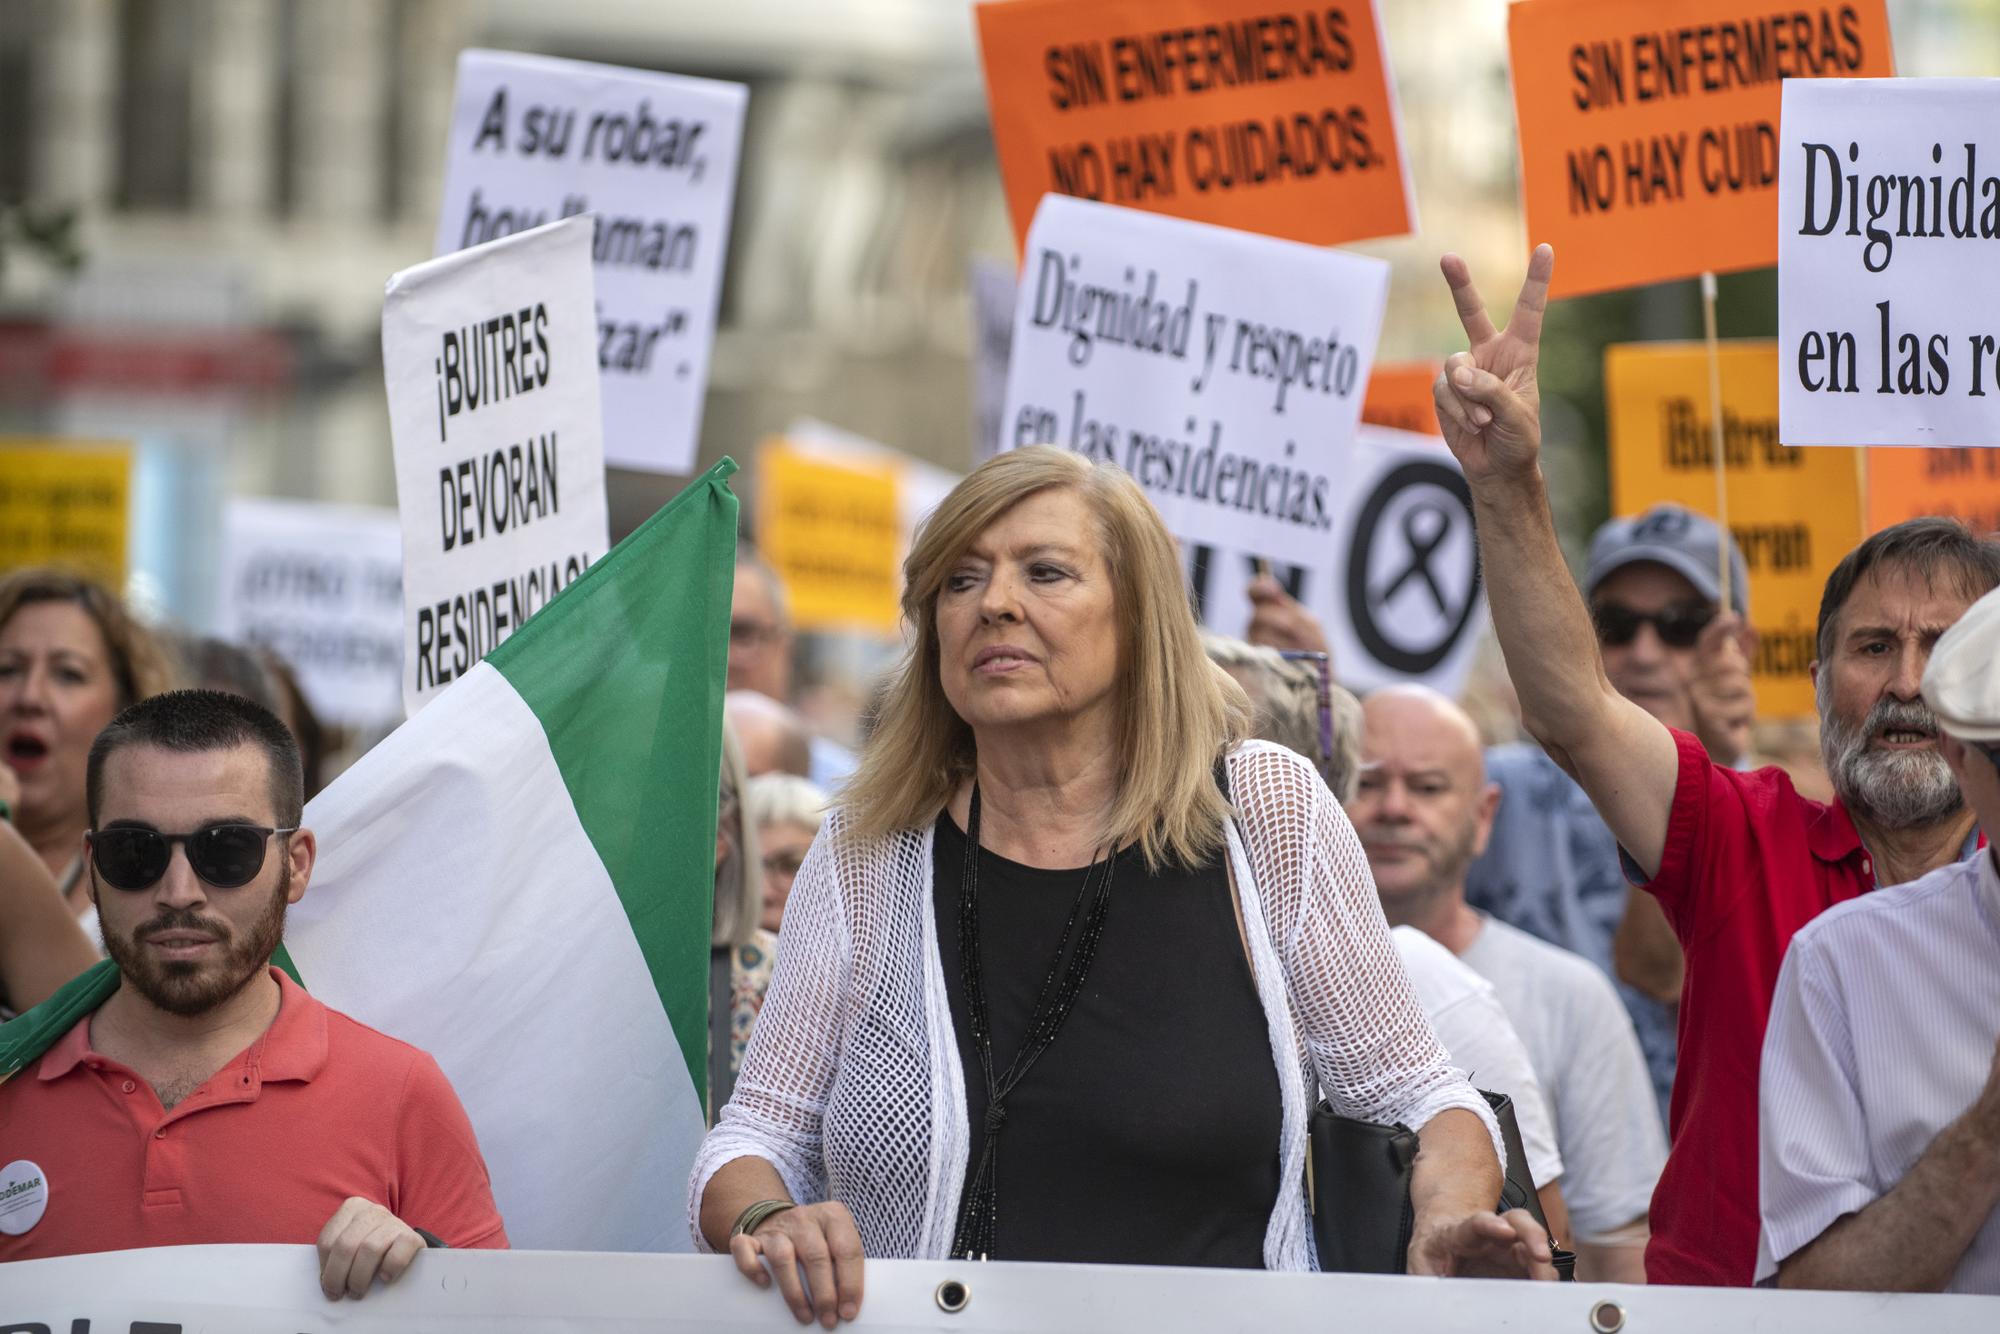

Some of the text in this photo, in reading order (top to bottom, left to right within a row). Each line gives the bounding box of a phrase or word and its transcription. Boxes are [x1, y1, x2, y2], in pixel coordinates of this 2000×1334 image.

[1045, 8, 1356, 111] SIN ENFERMERAS
[1570, 5, 1864, 111] SIN ENFERMERAS
[473, 84, 708, 182] A su robar,
[1047, 104, 1385, 202] NO HAY CUIDADOS.
[1568, 143, 1617, 217] NO
[1620, 130, 1688, 208] HAY
[436, 302, 550, 442] ¡BUITRES
[1031, 248, 1359, 414] Dignidad y respeto
[1799, 331, 1859, 393] en
[1876, 300, 1949, 396] las
[440, 431, 559, 552] DEVORAN
[1014, 390, 1332, 535] en las residencias.
